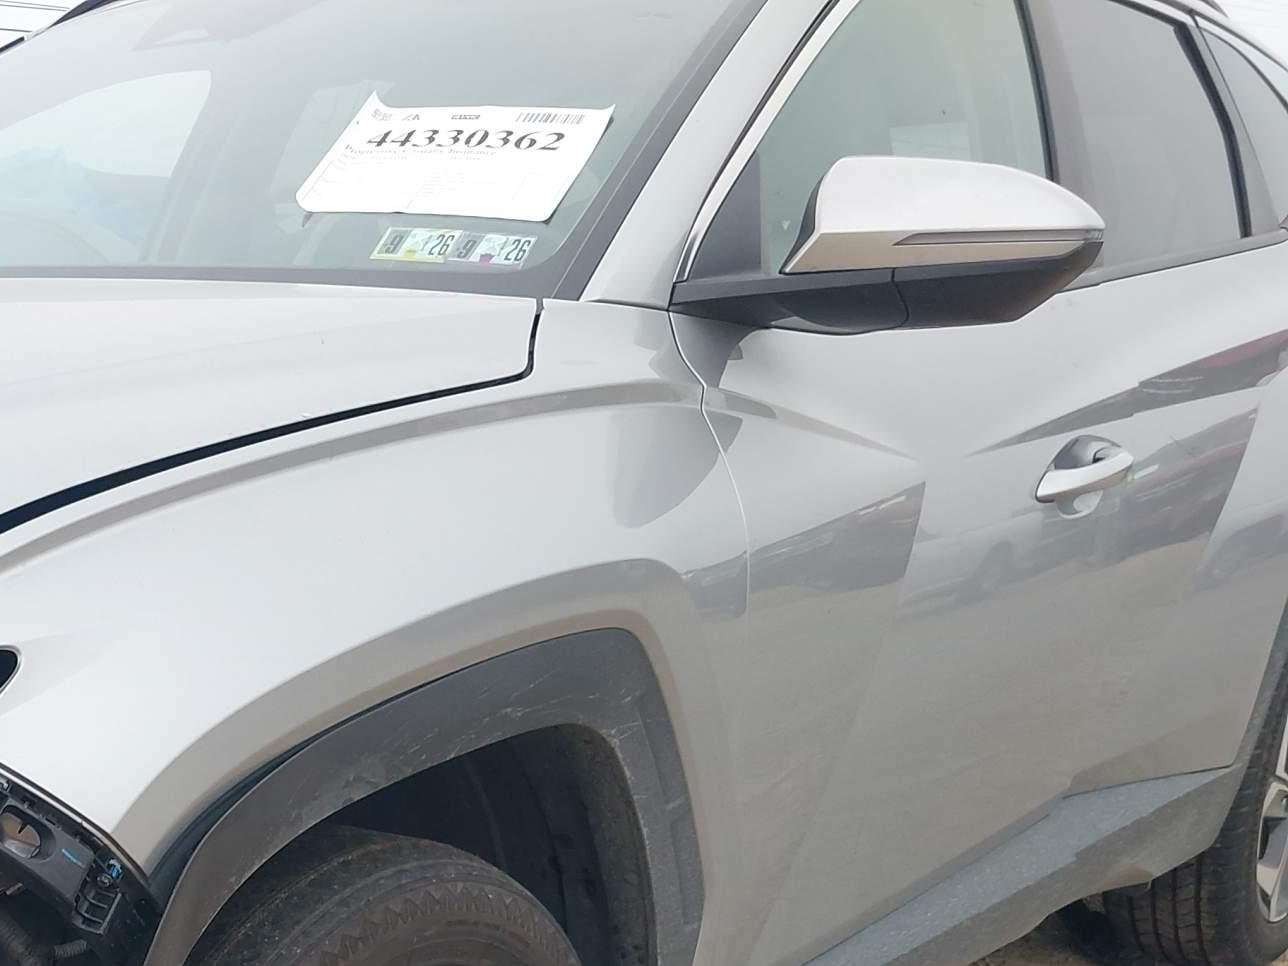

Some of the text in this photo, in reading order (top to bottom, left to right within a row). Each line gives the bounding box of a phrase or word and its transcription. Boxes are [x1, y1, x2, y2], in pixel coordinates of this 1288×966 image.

[366, 129, 565, 151] 44330362
[427, 233, 456, 256] 26
[504, 239, 532, 261] 26
